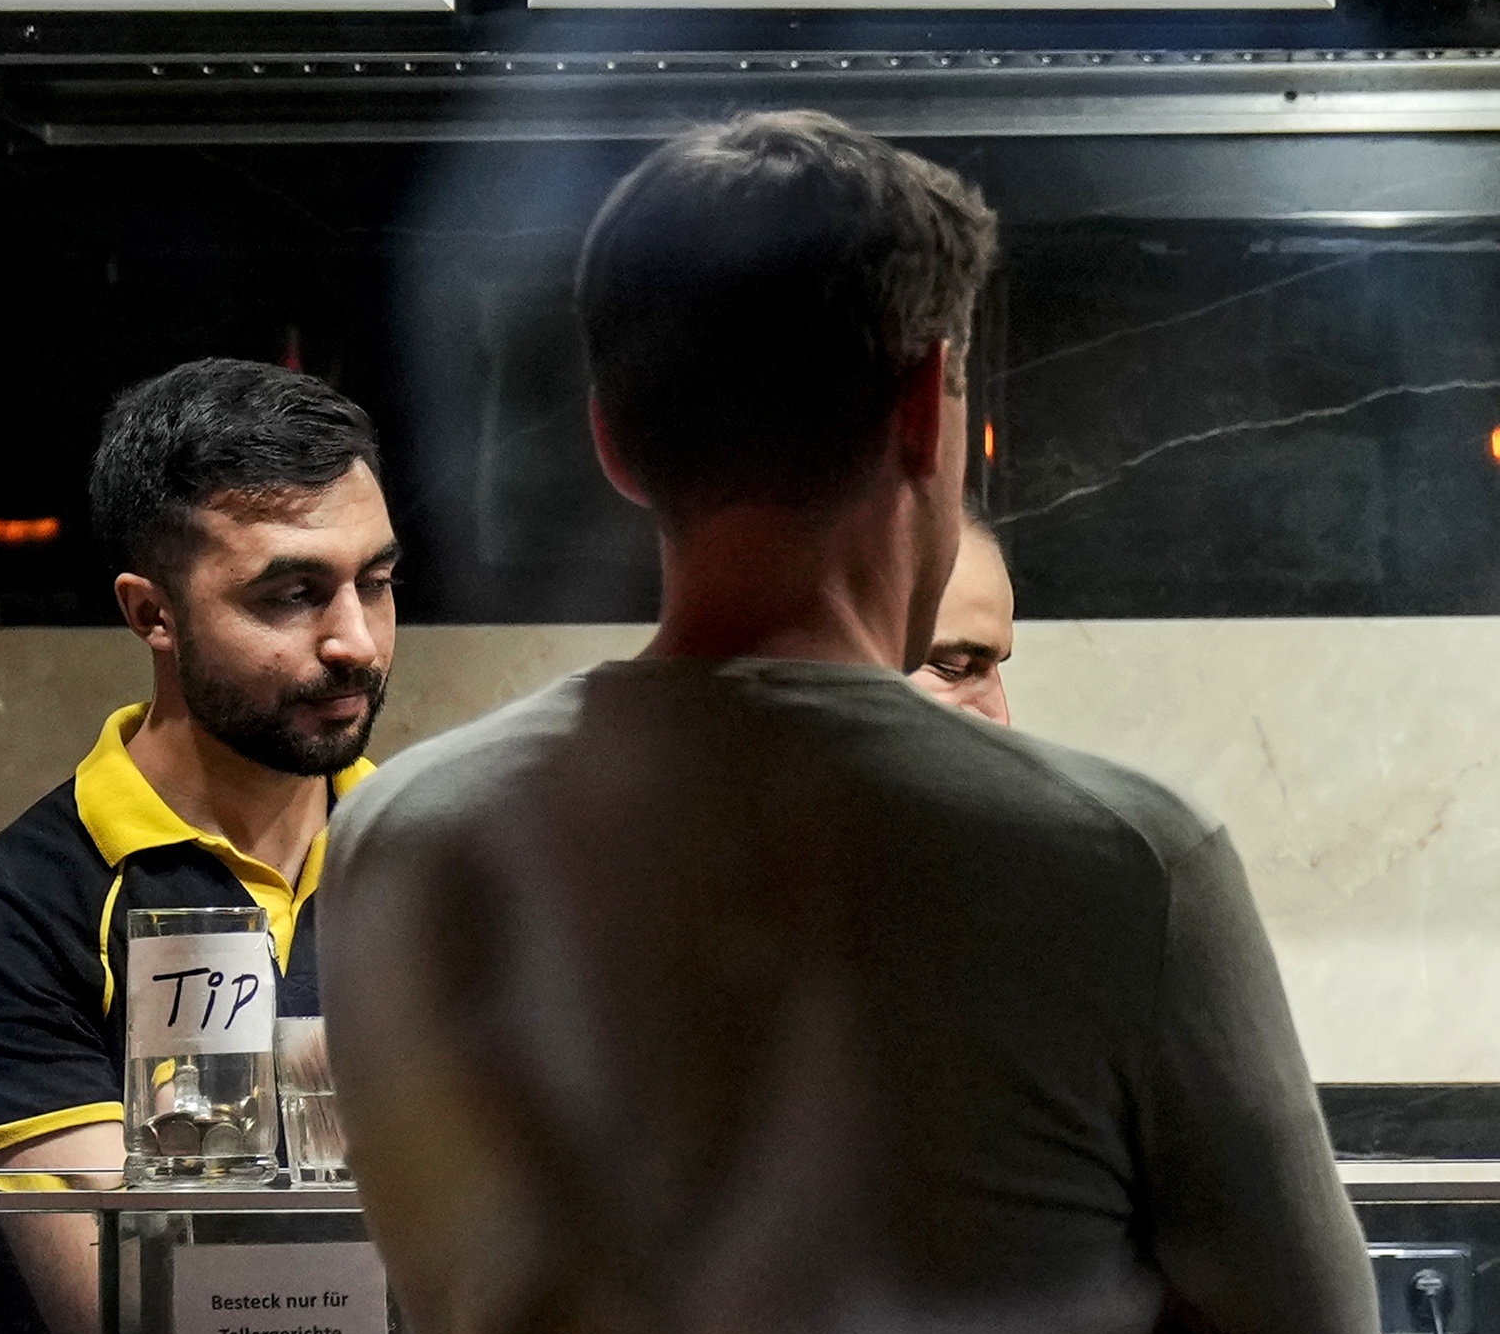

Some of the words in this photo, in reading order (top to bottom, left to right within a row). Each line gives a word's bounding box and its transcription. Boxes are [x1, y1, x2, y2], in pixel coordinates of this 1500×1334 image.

[212, 1293, 280, 1310] Besteck
[287, 1296, 317, 1308] nur
[323, 1292, 348, 1307] für
